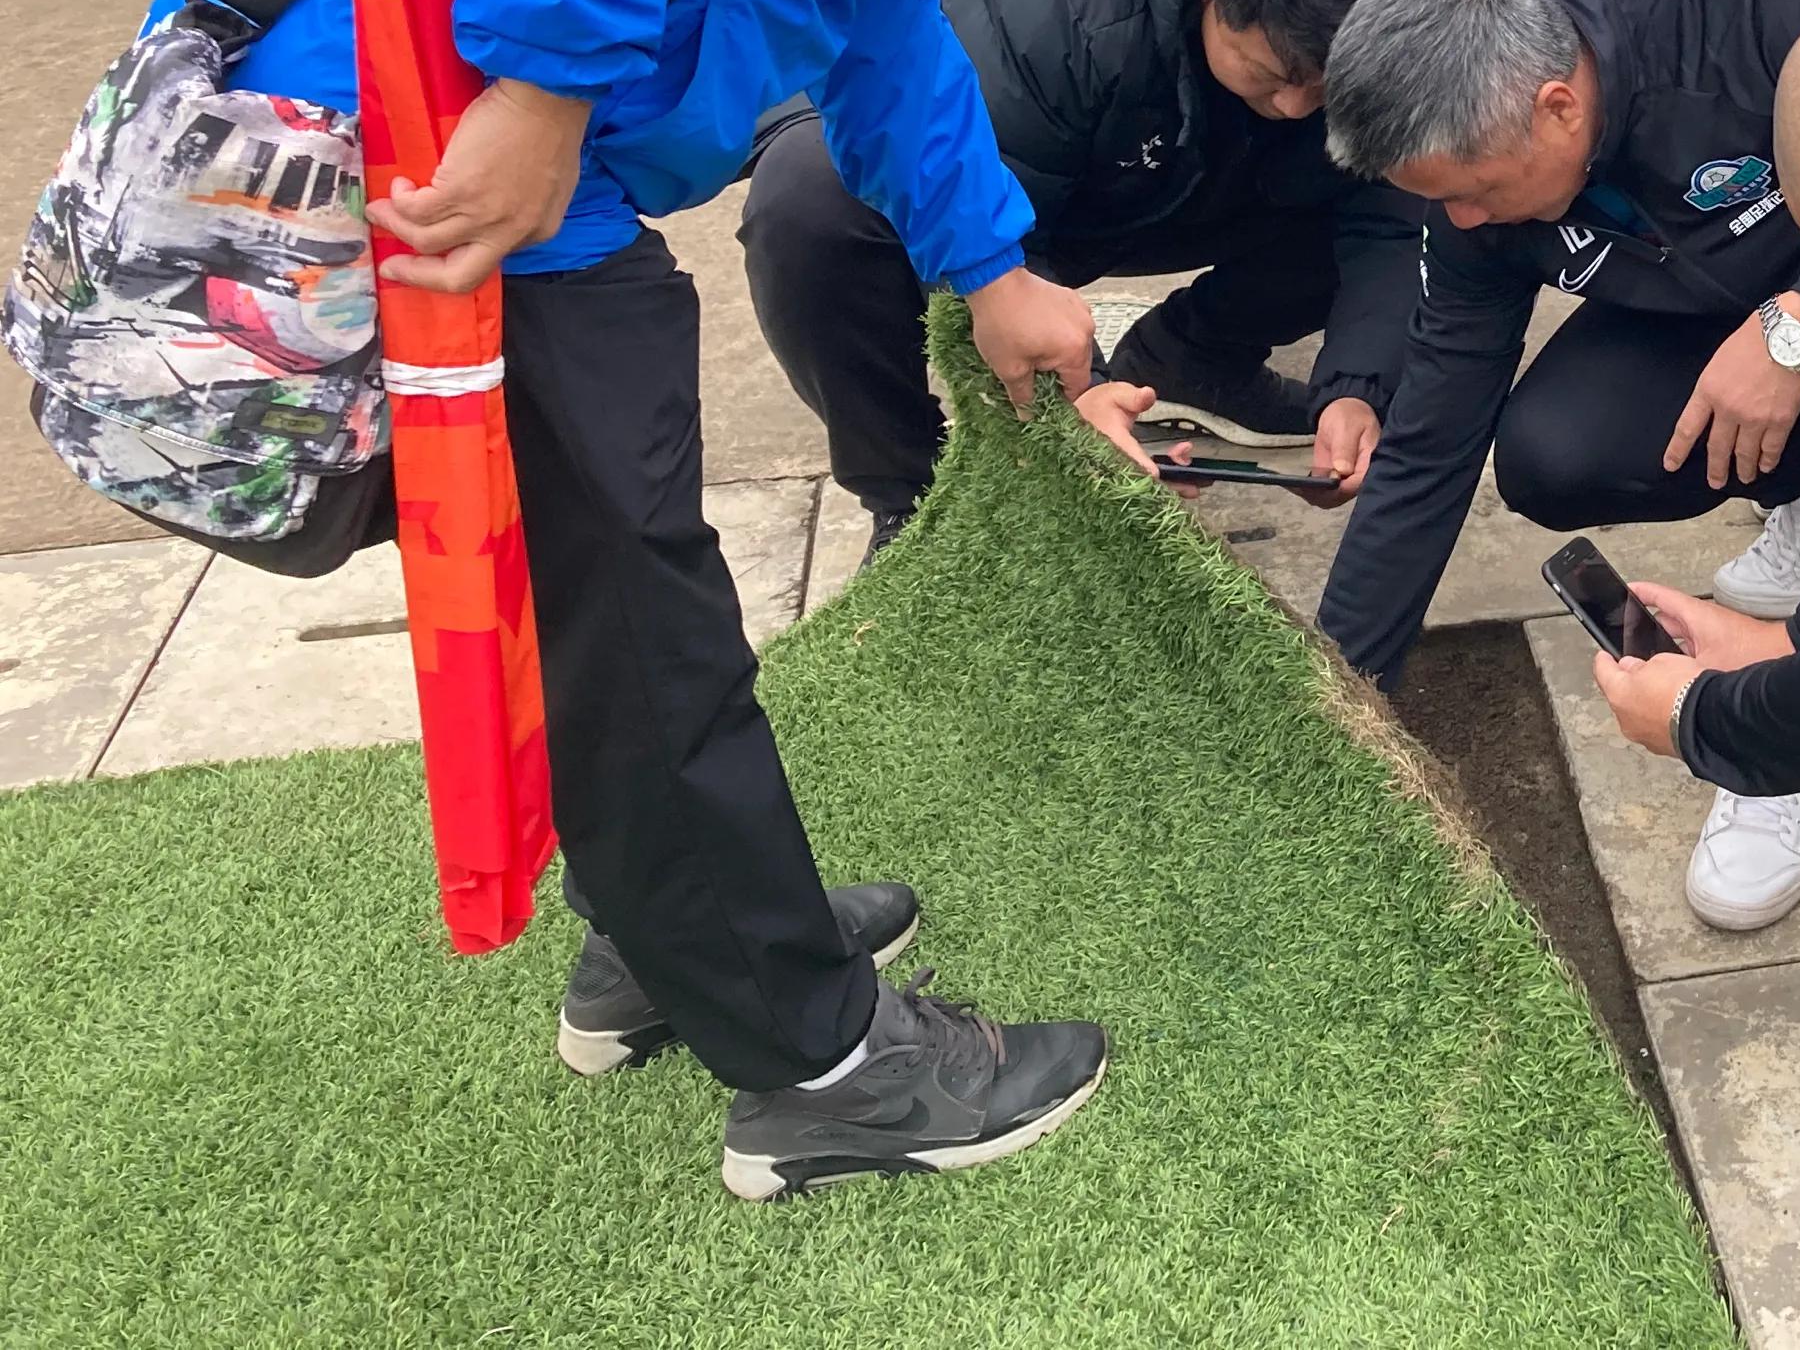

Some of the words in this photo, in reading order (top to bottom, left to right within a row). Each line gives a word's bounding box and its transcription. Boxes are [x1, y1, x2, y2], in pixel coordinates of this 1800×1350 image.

[1728, 187, 1786, 237] 全国足球记
